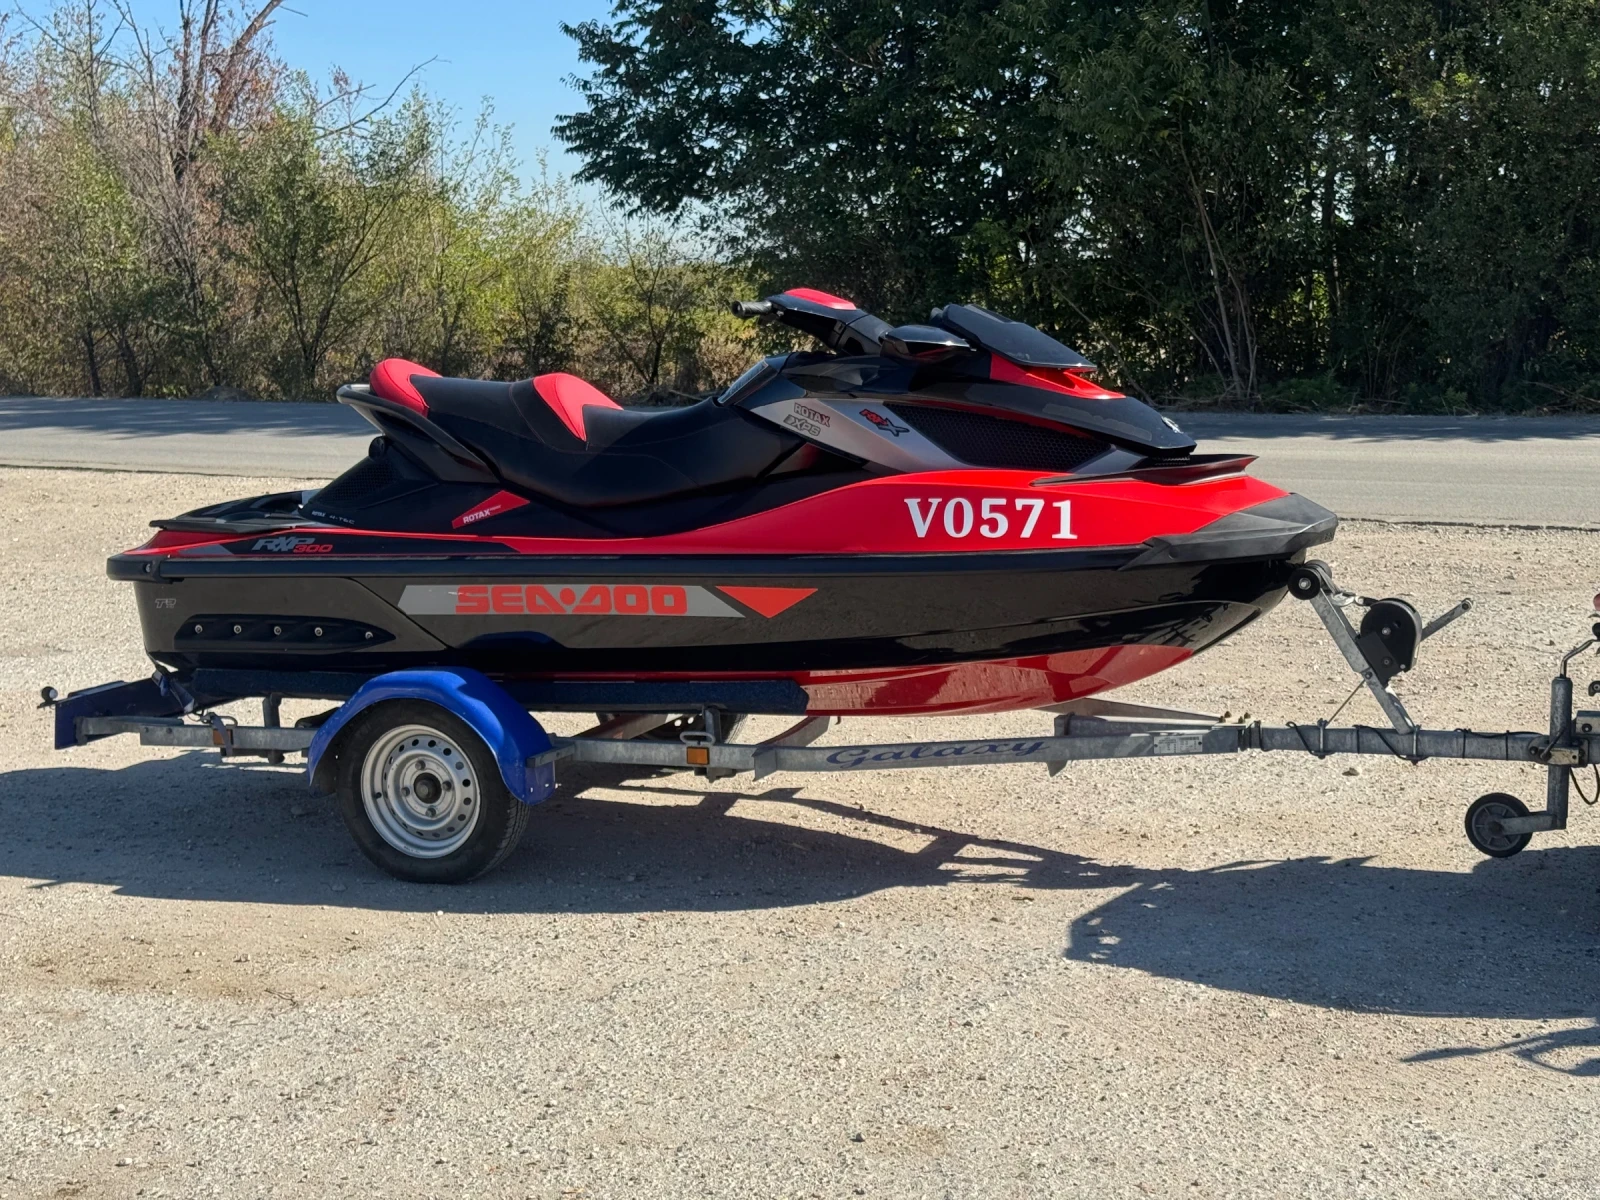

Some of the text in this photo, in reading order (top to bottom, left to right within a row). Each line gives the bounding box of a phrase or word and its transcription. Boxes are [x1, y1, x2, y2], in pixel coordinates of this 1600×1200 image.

[794, 403, 830, 427] ROTAX
[463, 508, 491, 524] ROTAX
[904, 497, 1078, 540] V0571
[293, 544, 334, 553] 300
[826, 740, 1050, 769] Galaxy
